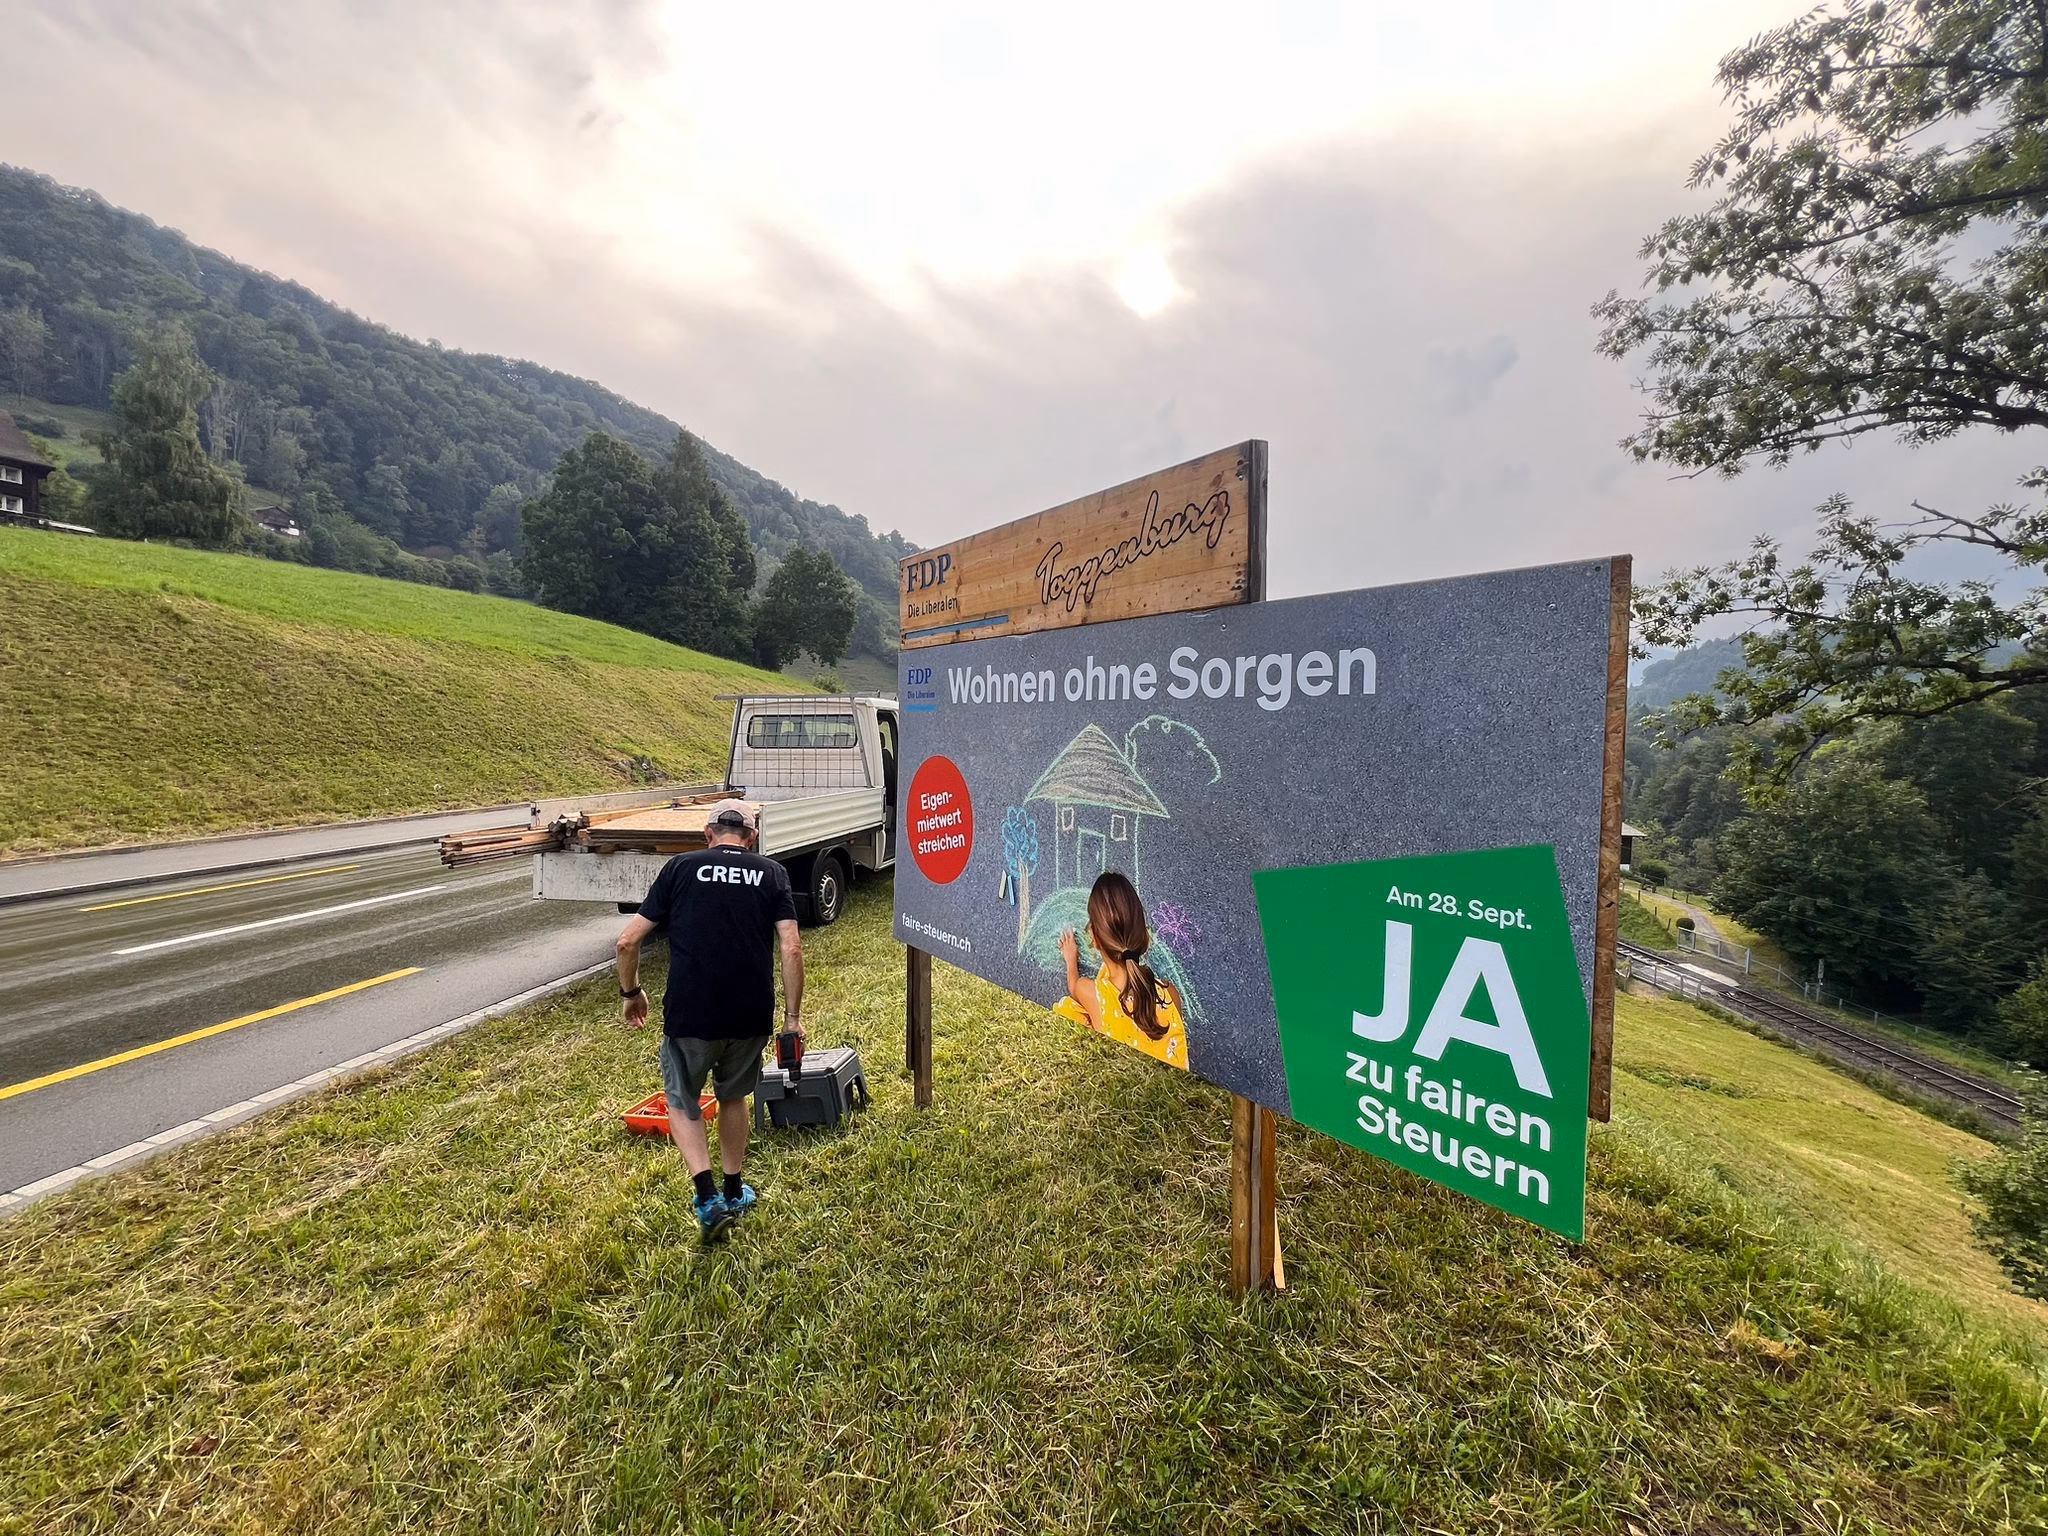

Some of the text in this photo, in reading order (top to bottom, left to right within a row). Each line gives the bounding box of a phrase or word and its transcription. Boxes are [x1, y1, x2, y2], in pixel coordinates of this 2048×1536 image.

[1036, 490, 1231, 612] Toggenburg
[906, 553, 952, 592] FDP
[908, 596, 958, 618] Die Liberalen
[907, 667, 932, 685] FDP
[948, 645, 1378, 712] Wohnen ohne Sorgen
[920, 791, 953, 811] Eigen-
[916, 812, 962, 834] mietwert
[917, 833, 966, 855] streichen
[696, 865, 764, 887] CREW
[1386, 886, 1532, 929] Am 28. Sept.
[901, 912, 971, 953] faire-steuern.ch
[1351, 919, 1553, 1099] JA
[1345, 1051, 1551, 1153] zu fairen
[1356, 1094, 1549, 1205] Steuern
